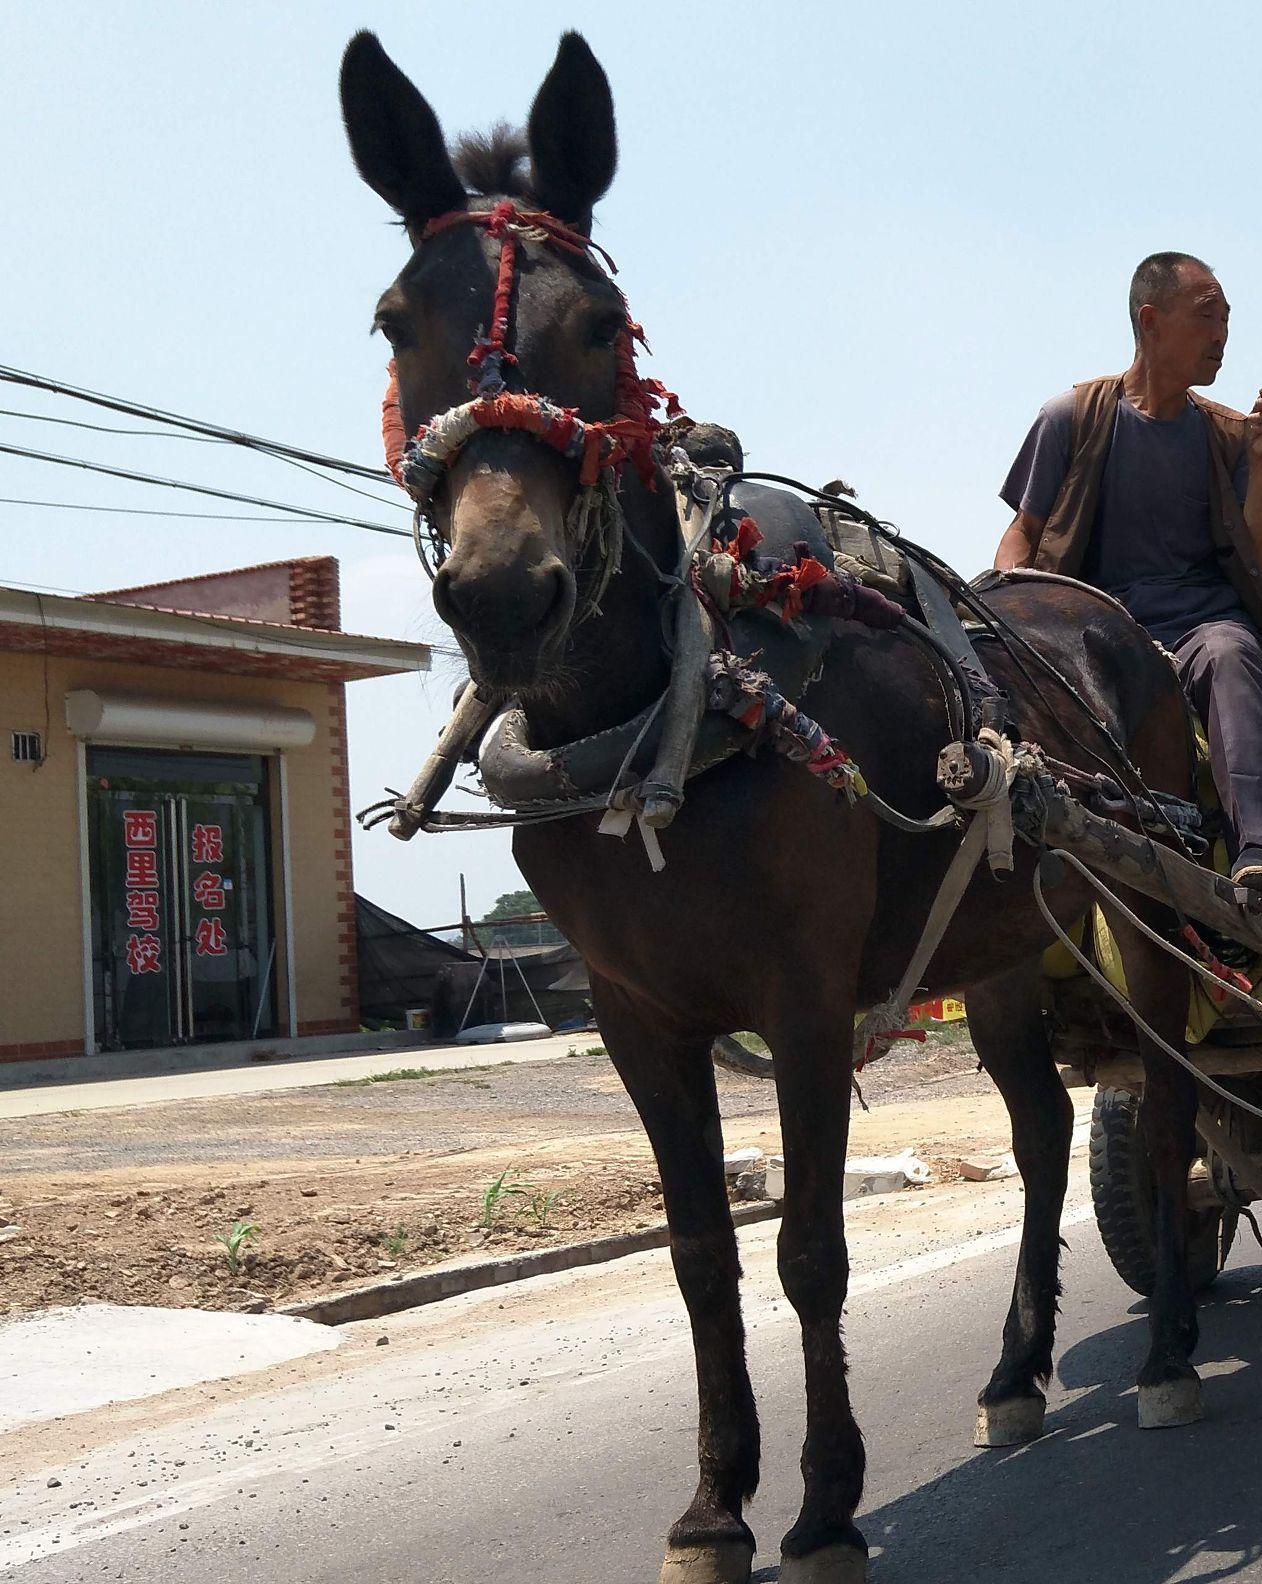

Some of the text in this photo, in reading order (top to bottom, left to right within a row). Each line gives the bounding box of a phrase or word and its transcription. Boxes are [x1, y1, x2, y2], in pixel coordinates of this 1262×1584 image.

[124, 811, 161, 974] 西里驾校
[192, 824, 227, 956] 报名处
